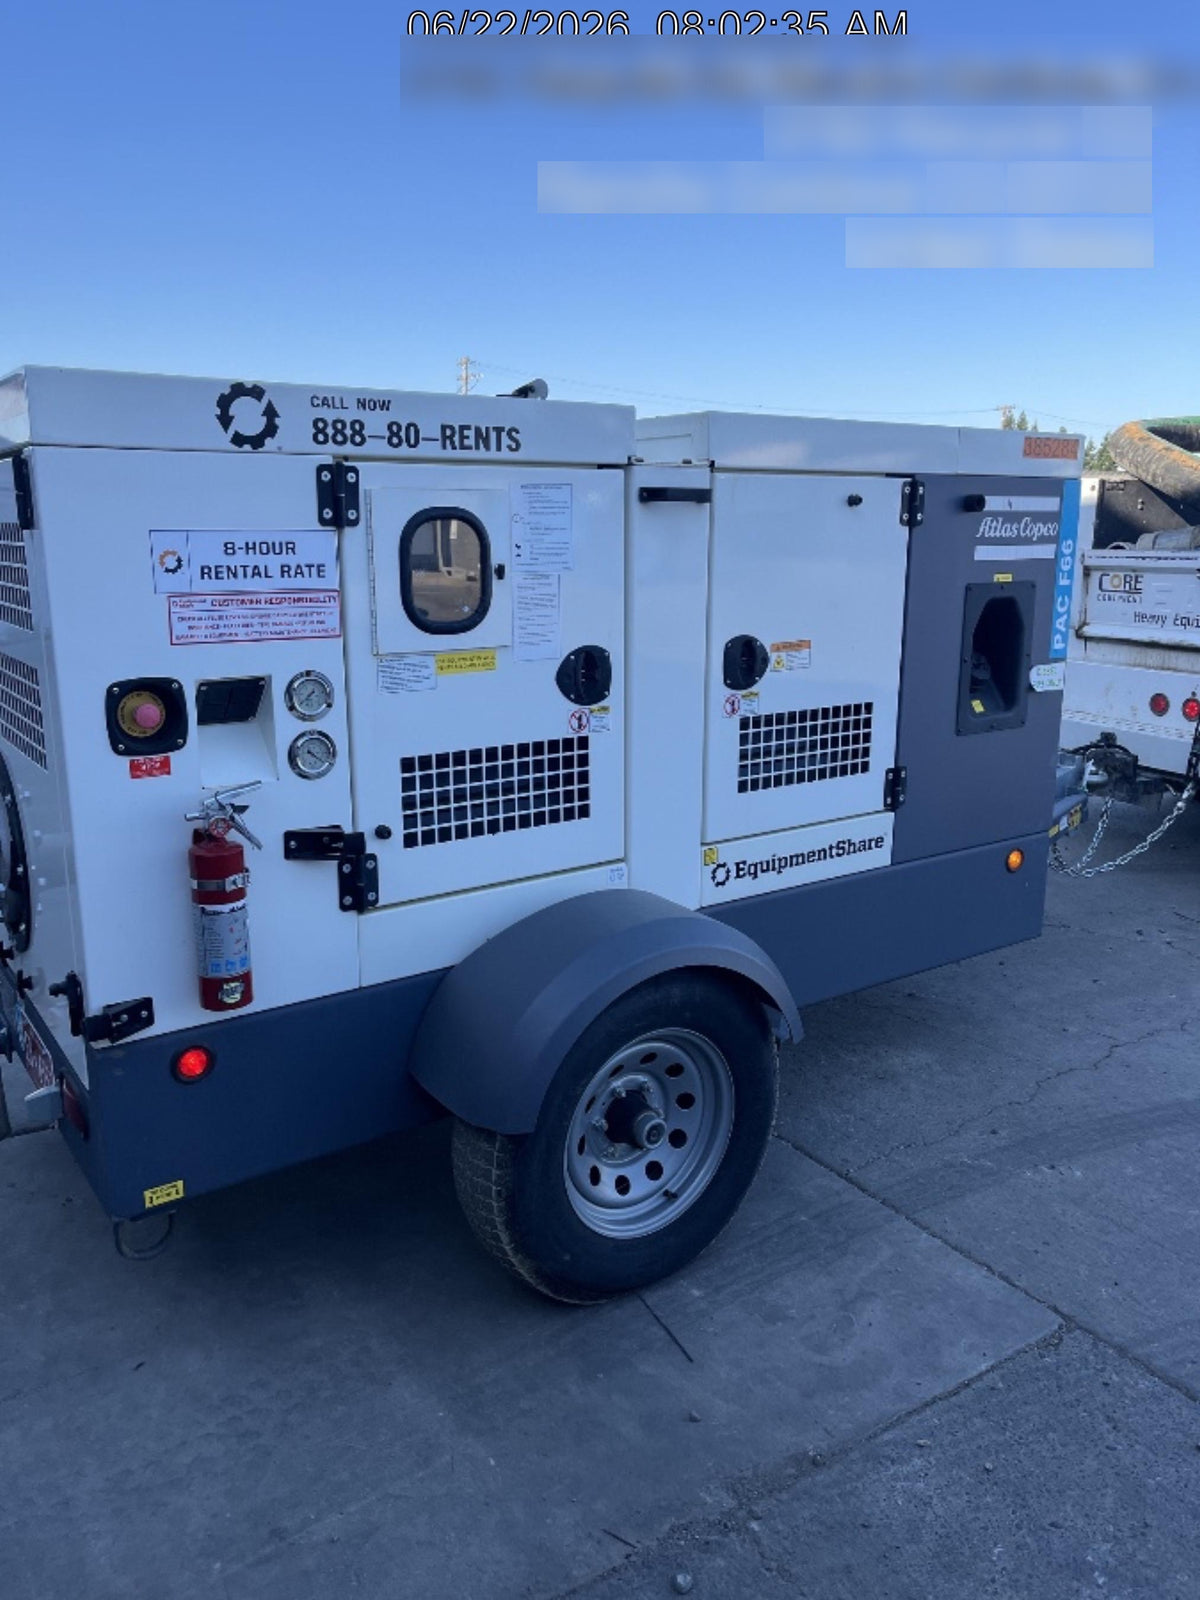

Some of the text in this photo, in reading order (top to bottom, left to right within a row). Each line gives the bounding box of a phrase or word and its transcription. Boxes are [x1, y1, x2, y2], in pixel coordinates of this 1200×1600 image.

[310, 395, 391, 412] CALL NOW
[312, 417, 521, 452] 888-80-RENTS
[976, 517, 1058, 541] Atlas Copco
[223, 541, 296, 556] 8-HOUR
[200, 563, 326, 581] RENTAL RATE
[1098, 573, 1144, 595] CORE
[1054, 594, 1070, 650] PAC
[1133, 611, 1167, 628] Heavy
[733, 834, 885, 881] EquipmentShare
